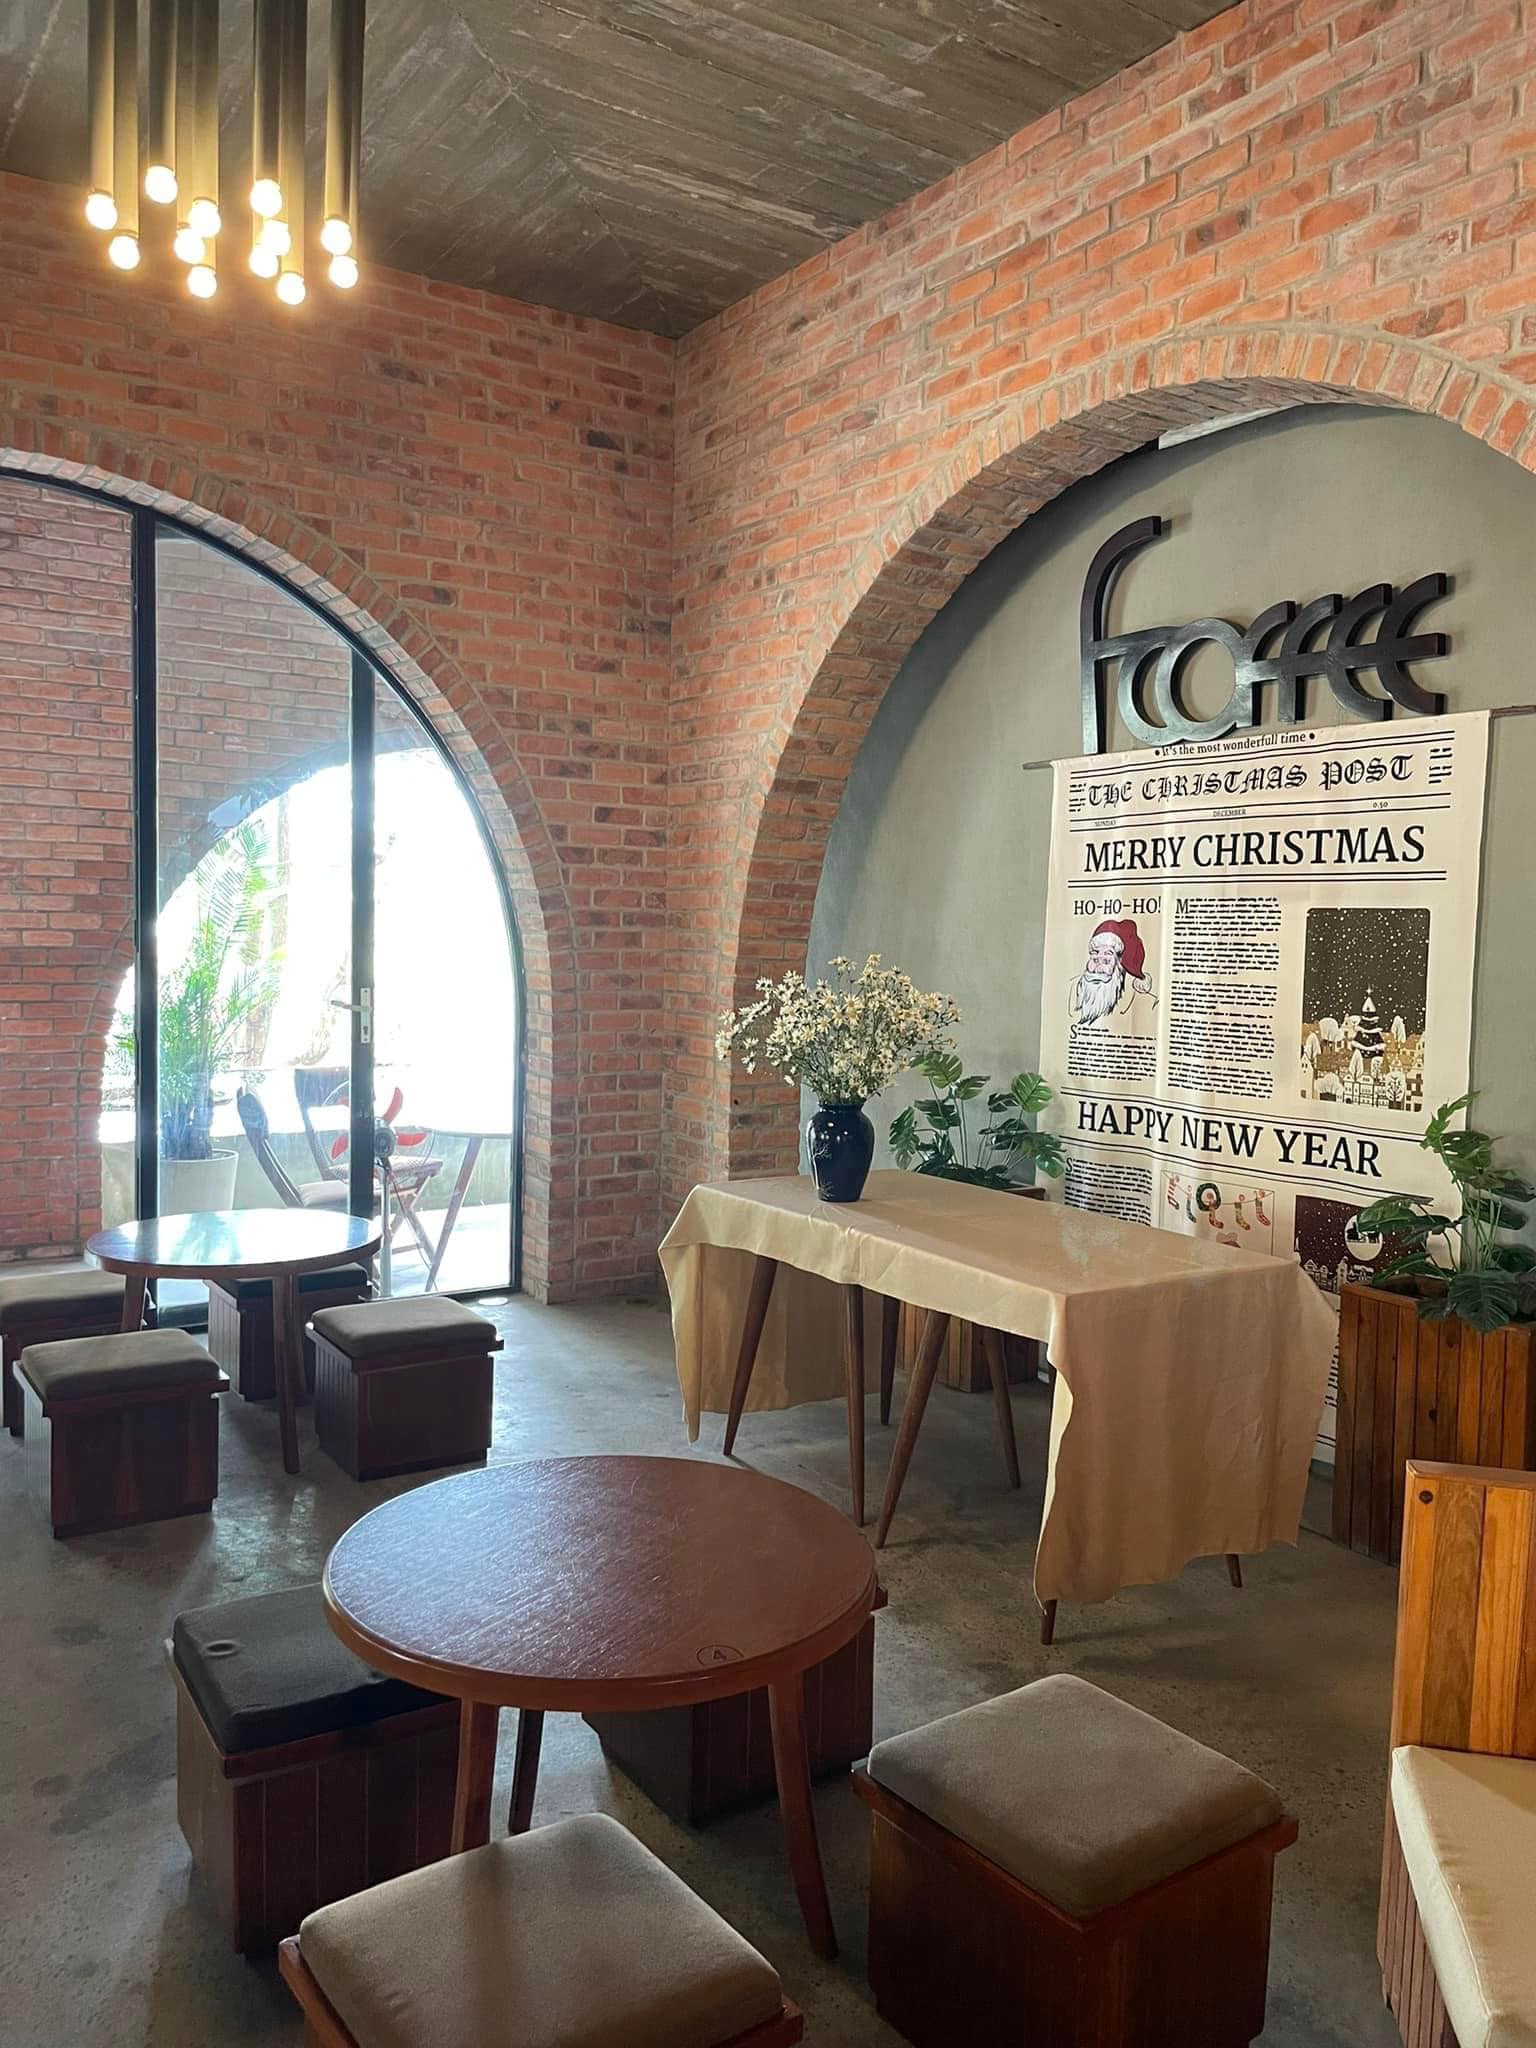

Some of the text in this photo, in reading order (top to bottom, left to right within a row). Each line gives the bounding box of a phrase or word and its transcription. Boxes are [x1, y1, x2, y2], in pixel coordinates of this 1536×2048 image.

[1179, 743, 1195, 755] the
[1197, 743, 1221, 753] most
[1222, 733, 1278, 751] wonderfull
[1280, 732, 1306, 745] time
[1088, 780, 1133, 808] THE
[1142, 764, 1307, 803] CHRISTMAS
[1319, 754, 1414, 790] POST
[1083, 825, 1426, 873] MERRY CHRISTMAS
[1077, 1100, 1382, 1178] HAPPY NEW YEAR
